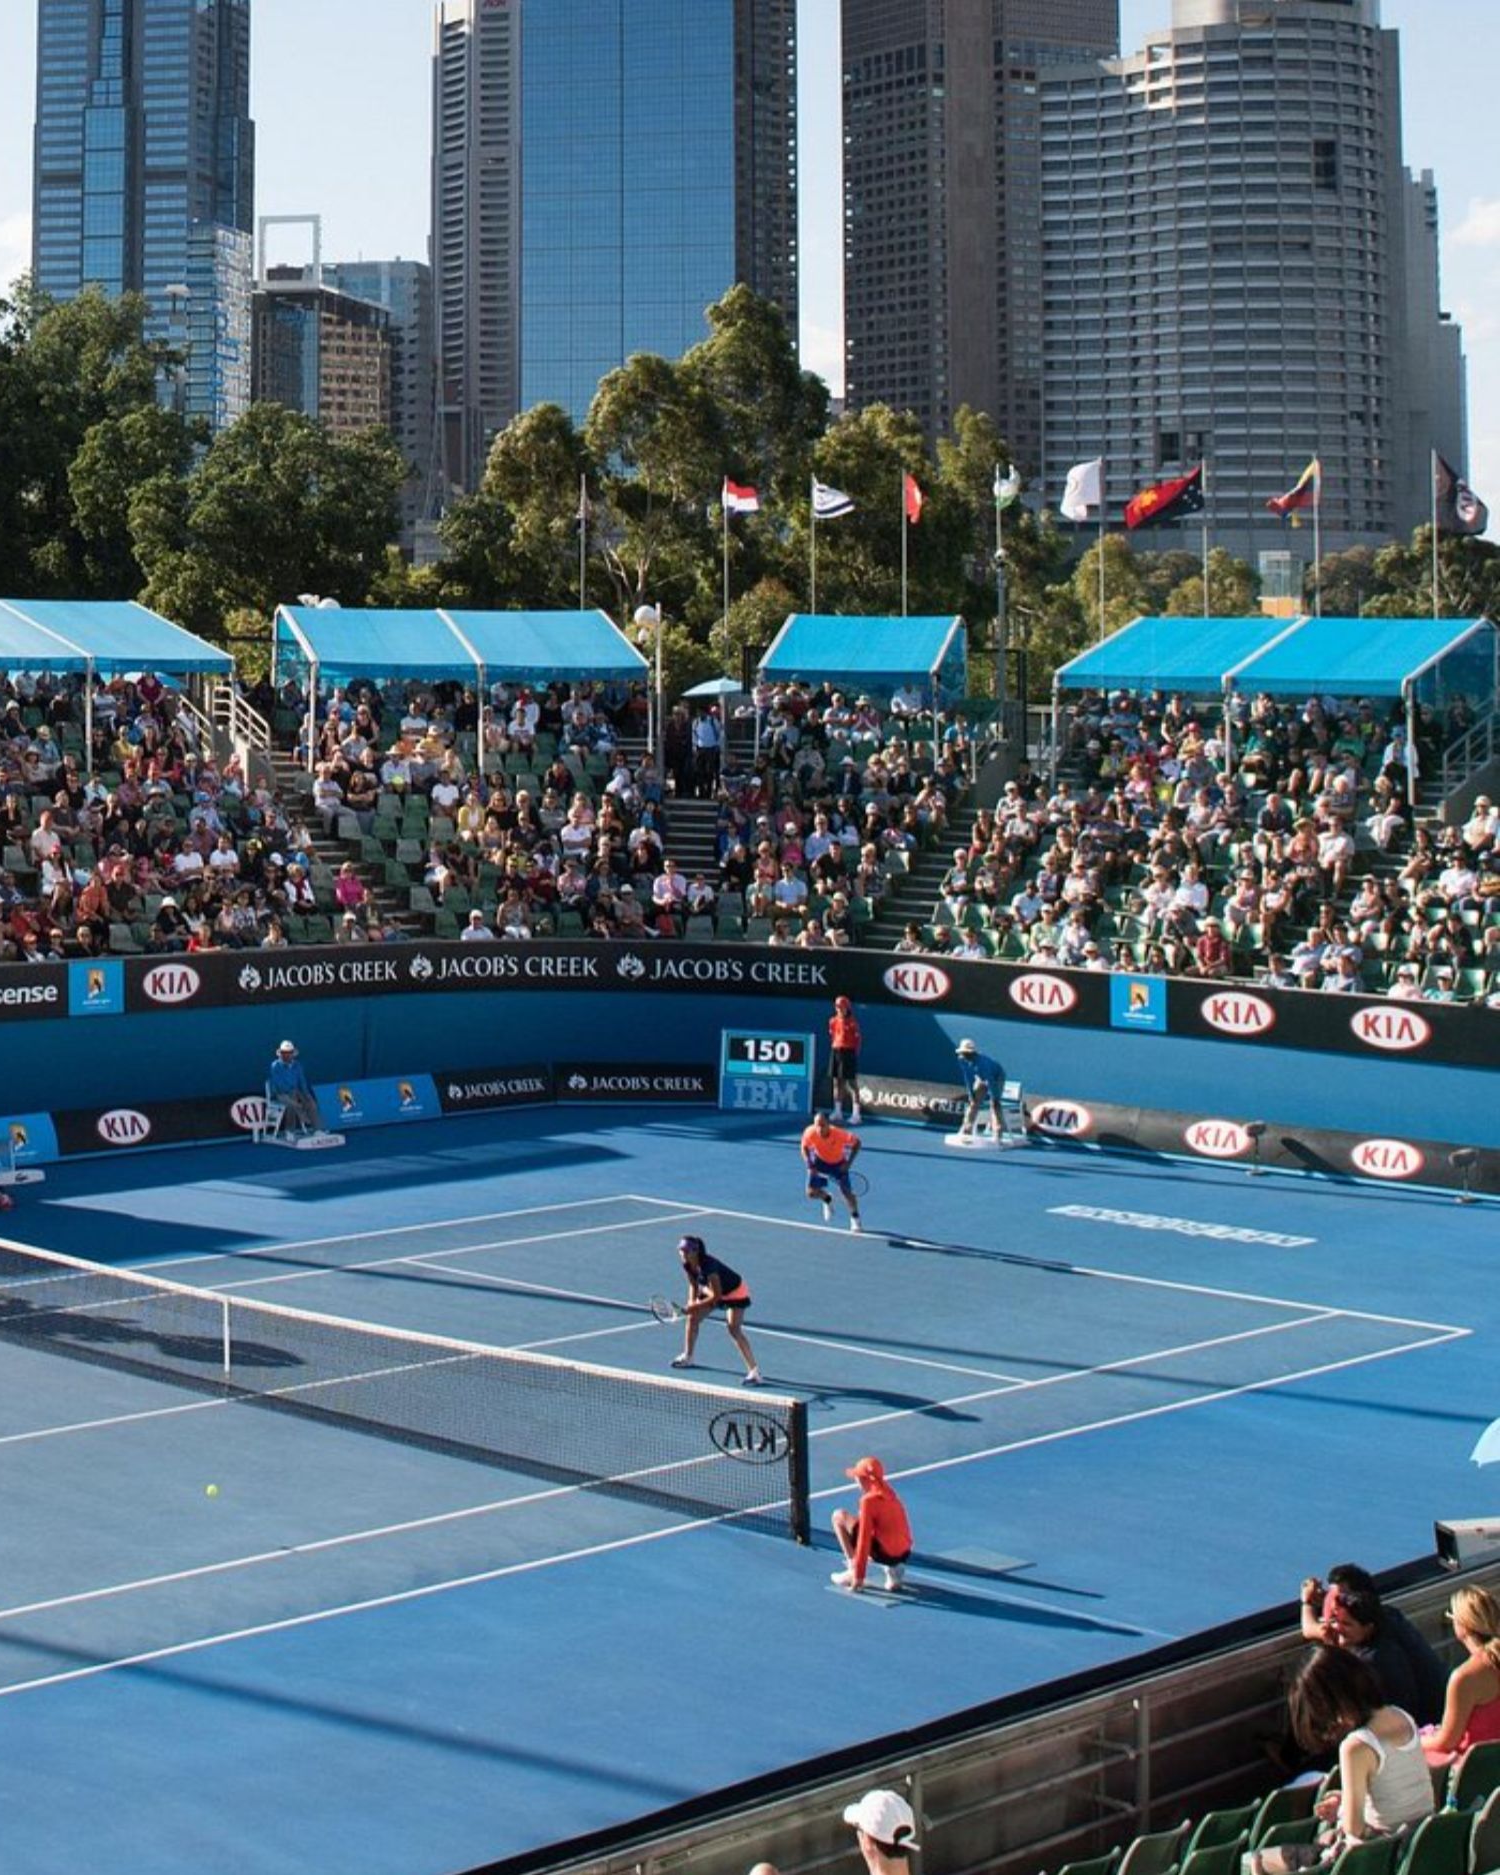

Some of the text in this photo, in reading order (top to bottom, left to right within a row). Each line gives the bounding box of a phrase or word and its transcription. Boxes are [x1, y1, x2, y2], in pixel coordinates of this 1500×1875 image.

[264, 960, 398, 990] JACOB'S CREEK
[437, 954, 599, 981] JACOB'S CREEK
[649, 957, 828, 986] JACOB'S CREEK
[151, 973, 192, 995] KIA
[892, 970, 940, 994] KIA
[1019, 981, 1066, 1008] KIA
[1211, 1000, 1262, 1028] KIA
[1362, 1013, 1419, 1043] KIA
[744, 1039, 792, 1062] 150
[508, 1077, 545, 1094] CREEK
[590, 1075, 704, 1092] JACOB'S CREEK
[732, 1078, 799, 1111] IBM
[930, 1097, 970, 1115] CREE
[1038, 1107, 1079, 1130] KIA
[104, 1115, 146, 1138] KIA
[1198, 1126, 1239, 1151] KIA
[1361, 1146, 1410, 1173] KIA
